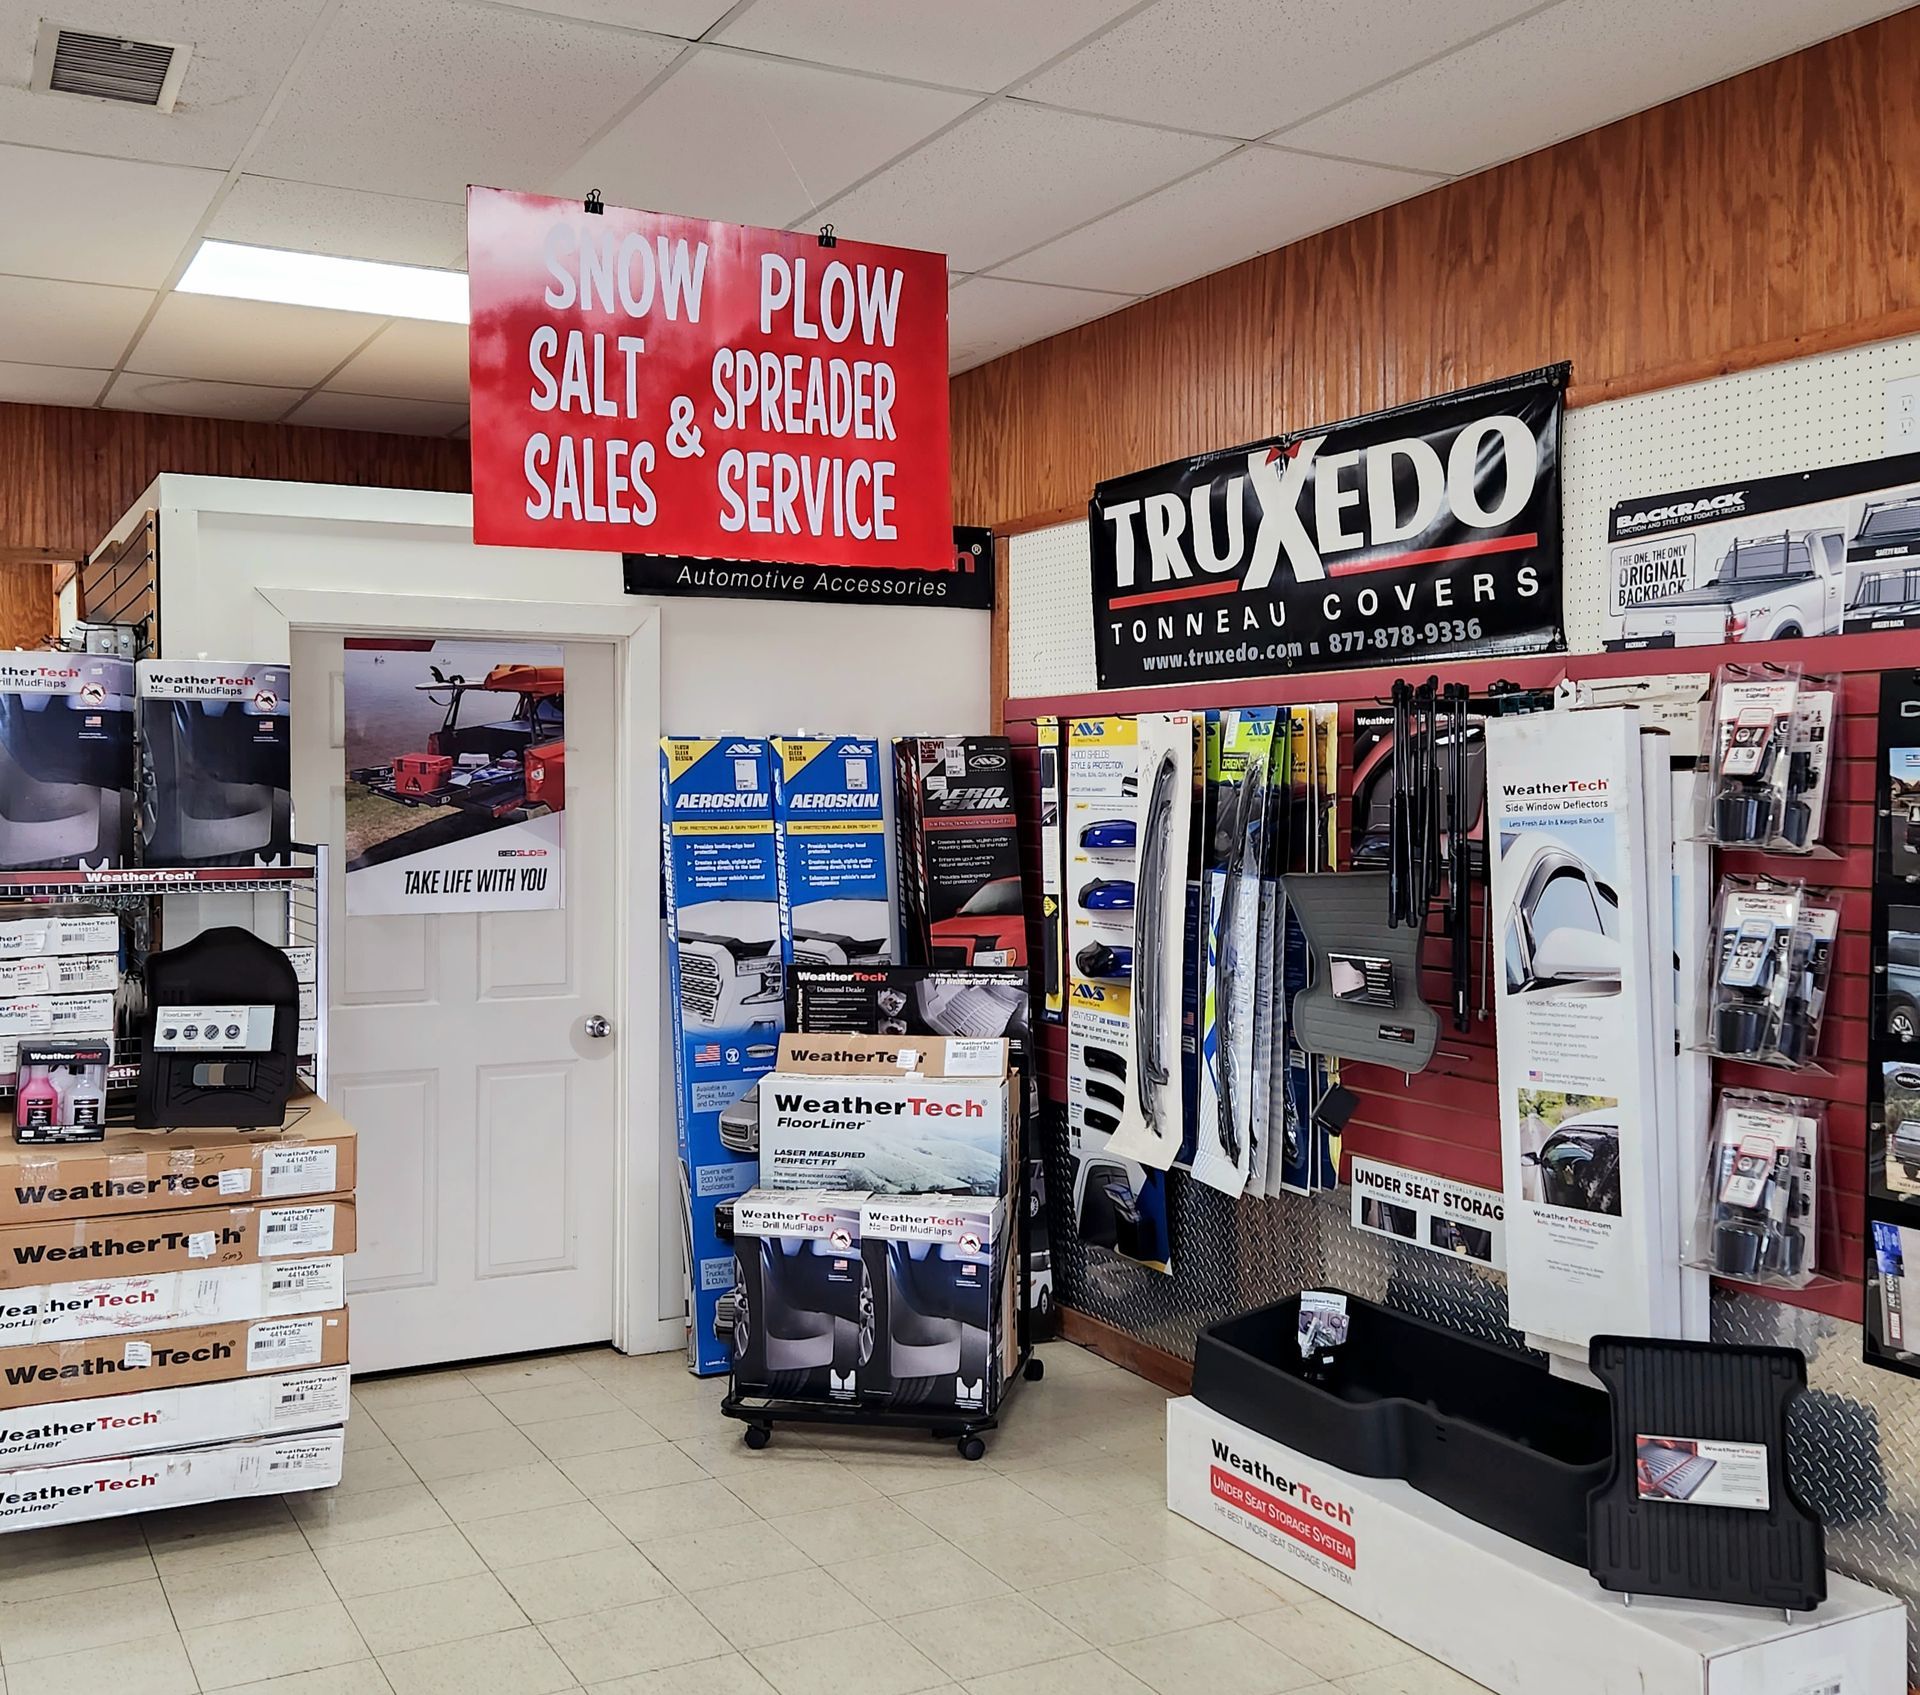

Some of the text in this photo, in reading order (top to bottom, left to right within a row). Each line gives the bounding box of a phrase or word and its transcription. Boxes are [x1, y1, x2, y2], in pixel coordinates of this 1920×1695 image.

[544, 223, 904, 347] SNOW PLOW
[528, 324, 897, 441] SALT SPREADER
[524, 395, 898, 540] SALES & SERVICE
[1103, 415, 1537, 590] TRUXEDO
[1616, 492, 1746, 529] BACKRACK
[1616, 525, 1647, 536] FUNCTION
[1662, 519, 1679, 527] STYLE
[1680, 515, 1693, 524] FOR
[1694, 510, 1720, 520] TODAY'S
[1721, 505, 1746, 515] TRUCKS
[1619, 554, 1632, 566] THE
[1653, 549, 1666, 560] THE
[1668, 544, 1688, 558] ONLY
[1619, 558, 1687, 588] ORIGINAL
[677, 565, 947, 597] Automotive Accessories
[1111, 566, 1538, 645] TONNEAU COVERS
[1142, 617, 1482, 670] www.truxedo.com 877-878-9336
[0, 667, 78, 679] therTech
[150, 674, 255, 686] WeatherTech
[15, 679, 66, 689] MudFlaps
[196, 687, 243, 696] MudFlaps
[1072, 722, 1104, 736] AVS
[1357, 718, 1394, 726] Weather
[928, 787, 1005, 800] AERO
[1503, 779, 1608, 796] WeatherTech
[675, 793, 768, 808] AEROSKIN
[790, 793, 879, 808] AEROSKIN
[940, 797, 1009, 811] SKIN
[1505, 799, 1608, 812] Side Window Deflectors
[1539, 819, 1547, 827] Air
[1560, 818, 1577, 827] Keeps
[1579, 817, 1592, 825] Rain
[86, 870, 195, 883] WeatherTech
[404, 867, 548, 895] TAKE LIFE WITH YOU
[663, 822, 677, 943] AEROSKIN
[775, 823, 791, 942] AEROSKIN
[797, 972, 886, 981] WeatherTech
[1072, 984, 1106, 1001] AVS
[1568, 1002, 1587, 1010] Design
[30, 1052, 101, 1060] WeatherTech
[791, 1050, 924, 1063] WeatherTe
[775, 1094, 983, 1117] WeatherTech
[777, 1118, 866, 1130] FloorLiner
[700, 1168, 719, 1176] Covers
[15, 1171, 219, 1205] WeatherTec
[701, 1182, 735, 1191] Applications
[1355, 1168, 1401, 1194] UNDER
[1405, 1182, 1440, 1203] SEAT
[1443, 1192, 1504, 1221] STORAG
[741, 1209, 835, 1222] WeatherTech
[869, 1212, 964, 1226] WeatherTech
[1533, 1210, 1612, 1230] WeatherTech.com
[782, 1222, 824, 1232] MudFlaps
[910, 1225, 953, 1236] MudFlaps
[705, 1261, 732, 1270] Designed
[0, 1290, 156, 1319] eaherTech
[0, 1439, 62, 1454] oorLiner
[1211, 1438, 1352, 1526] WeatherTech
[0, 1502, 59, 1516] oorLiner
[1213, 1474, 1352, 1560] UNDER SEAT STORAGE SYSTEM
[1214, 1502, 1352, 1586] THE BEST UNDER SEAT STORAGE SYSTEM
